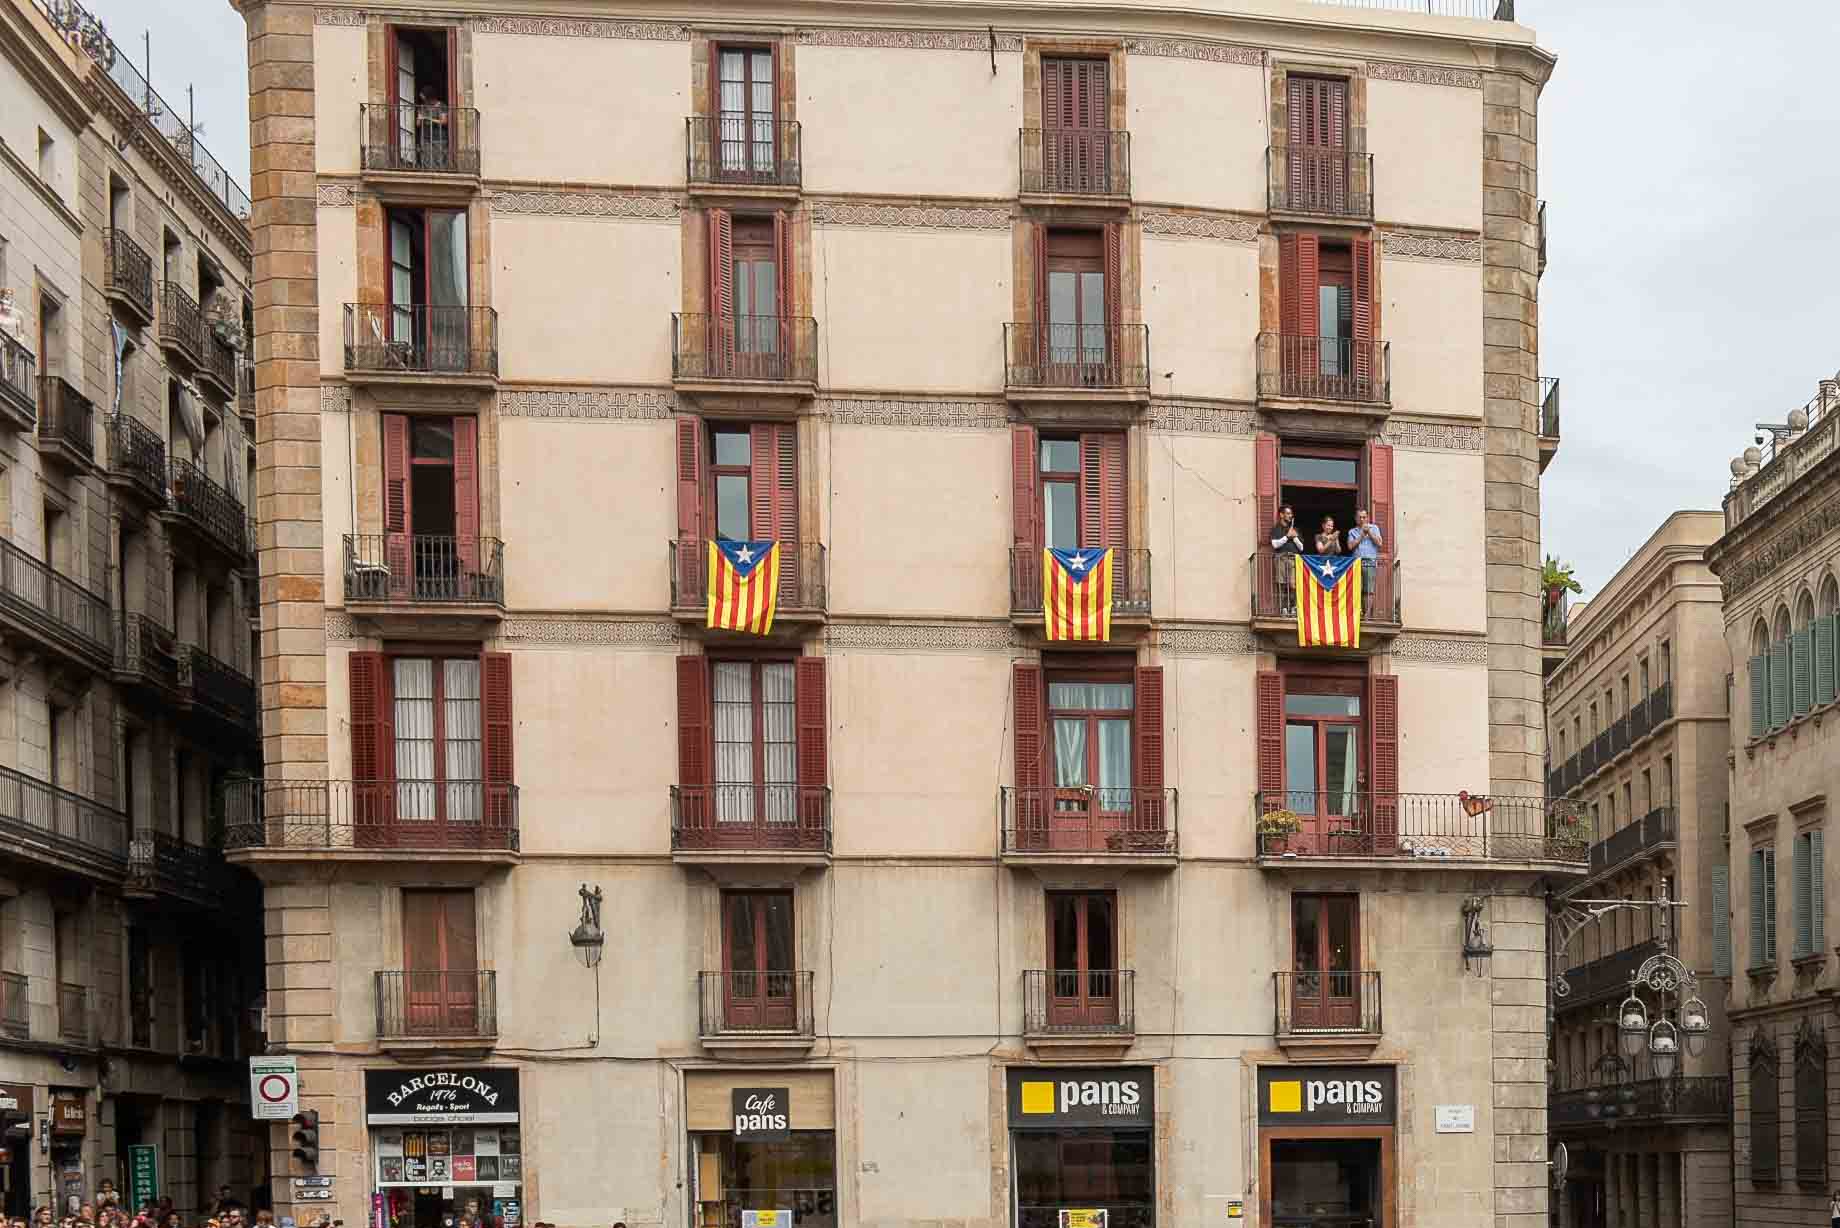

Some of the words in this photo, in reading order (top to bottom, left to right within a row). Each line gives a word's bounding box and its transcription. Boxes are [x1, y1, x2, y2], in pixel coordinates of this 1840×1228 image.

[387, 1073, 498, 1107] BARCELONA
[430, 1089, 457, 1101] 1976
[1061, 1081, 1140, 1113] pans
[1307, 1080, 1383, 1112] pans
[1109, 1104, 1140, 1115] COMPANY
[1346, 1103, 1352, 1113] &
[1354, 1102, 1383, 1113] COMPANY
[736, 1114, 787, 1136] pans
